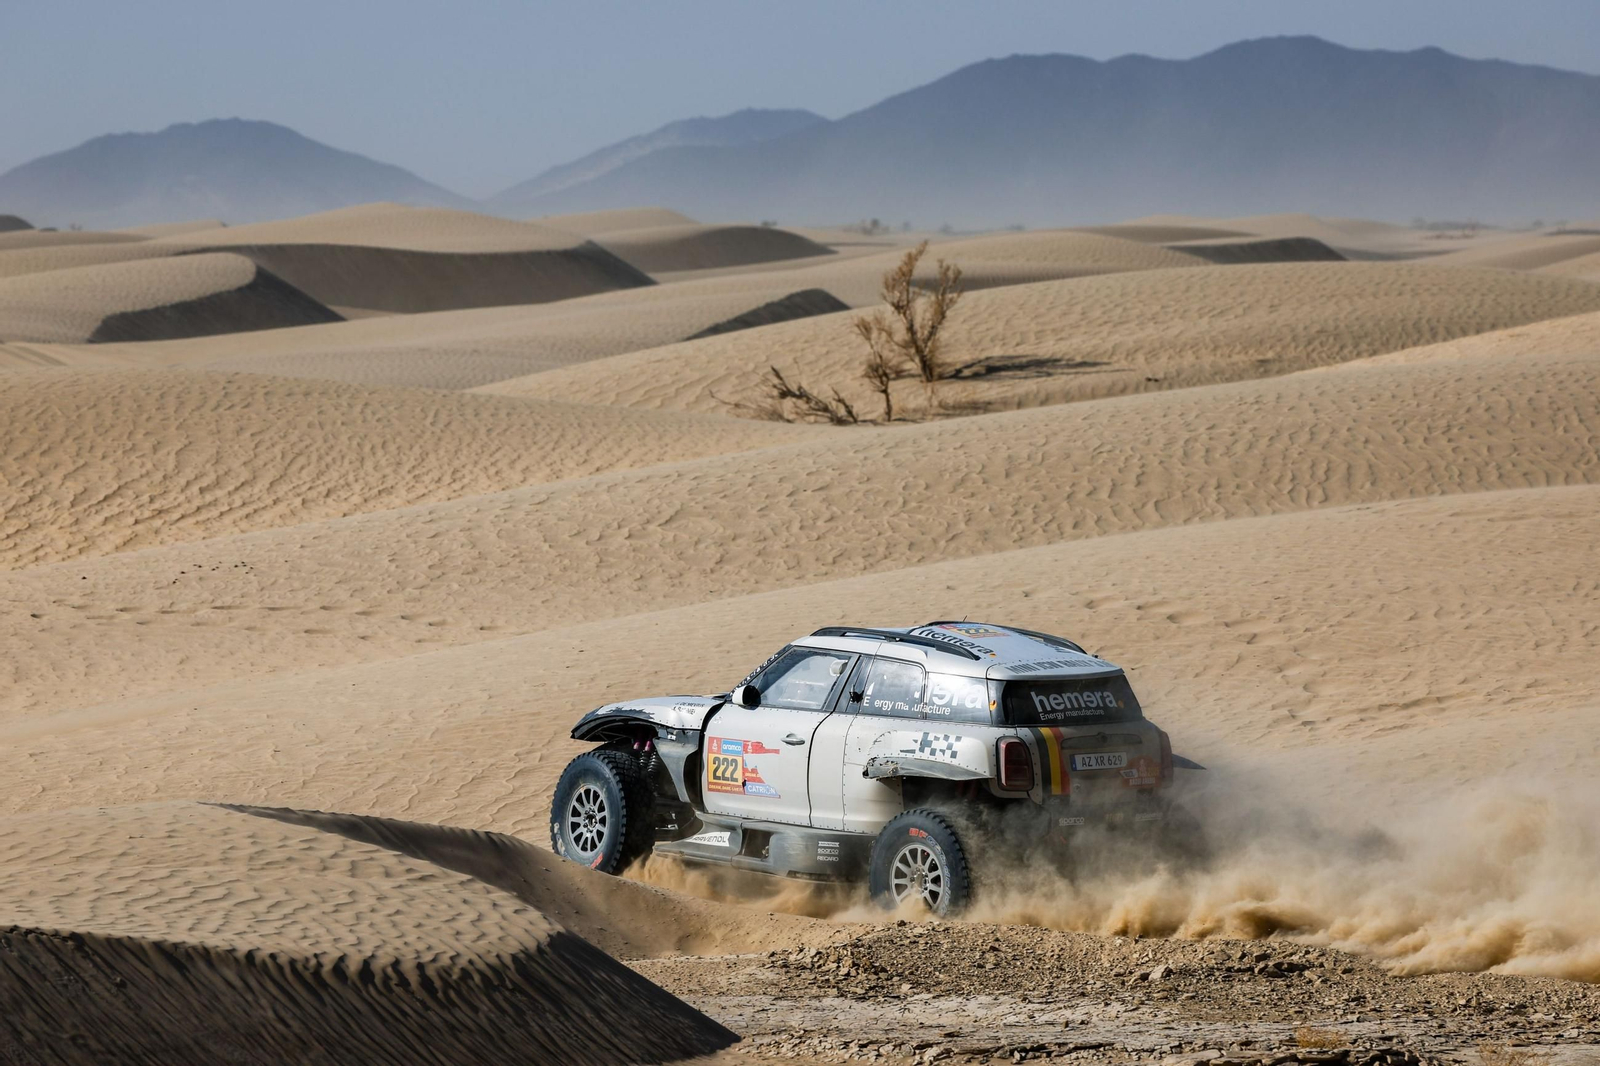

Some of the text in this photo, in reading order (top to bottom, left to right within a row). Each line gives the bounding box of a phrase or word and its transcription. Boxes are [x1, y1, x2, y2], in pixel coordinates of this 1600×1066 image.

[863, 696, 951, 716] Eergy maufacture
[1030, 690, 1118, 713] hemera
[1039, 708, 1105, 721] Energy manufacture
[722, 743, 742, 751] aramco
[712, 756, 739, 783] 222
[1081, 754, 1123, 768] AZ XR 629
